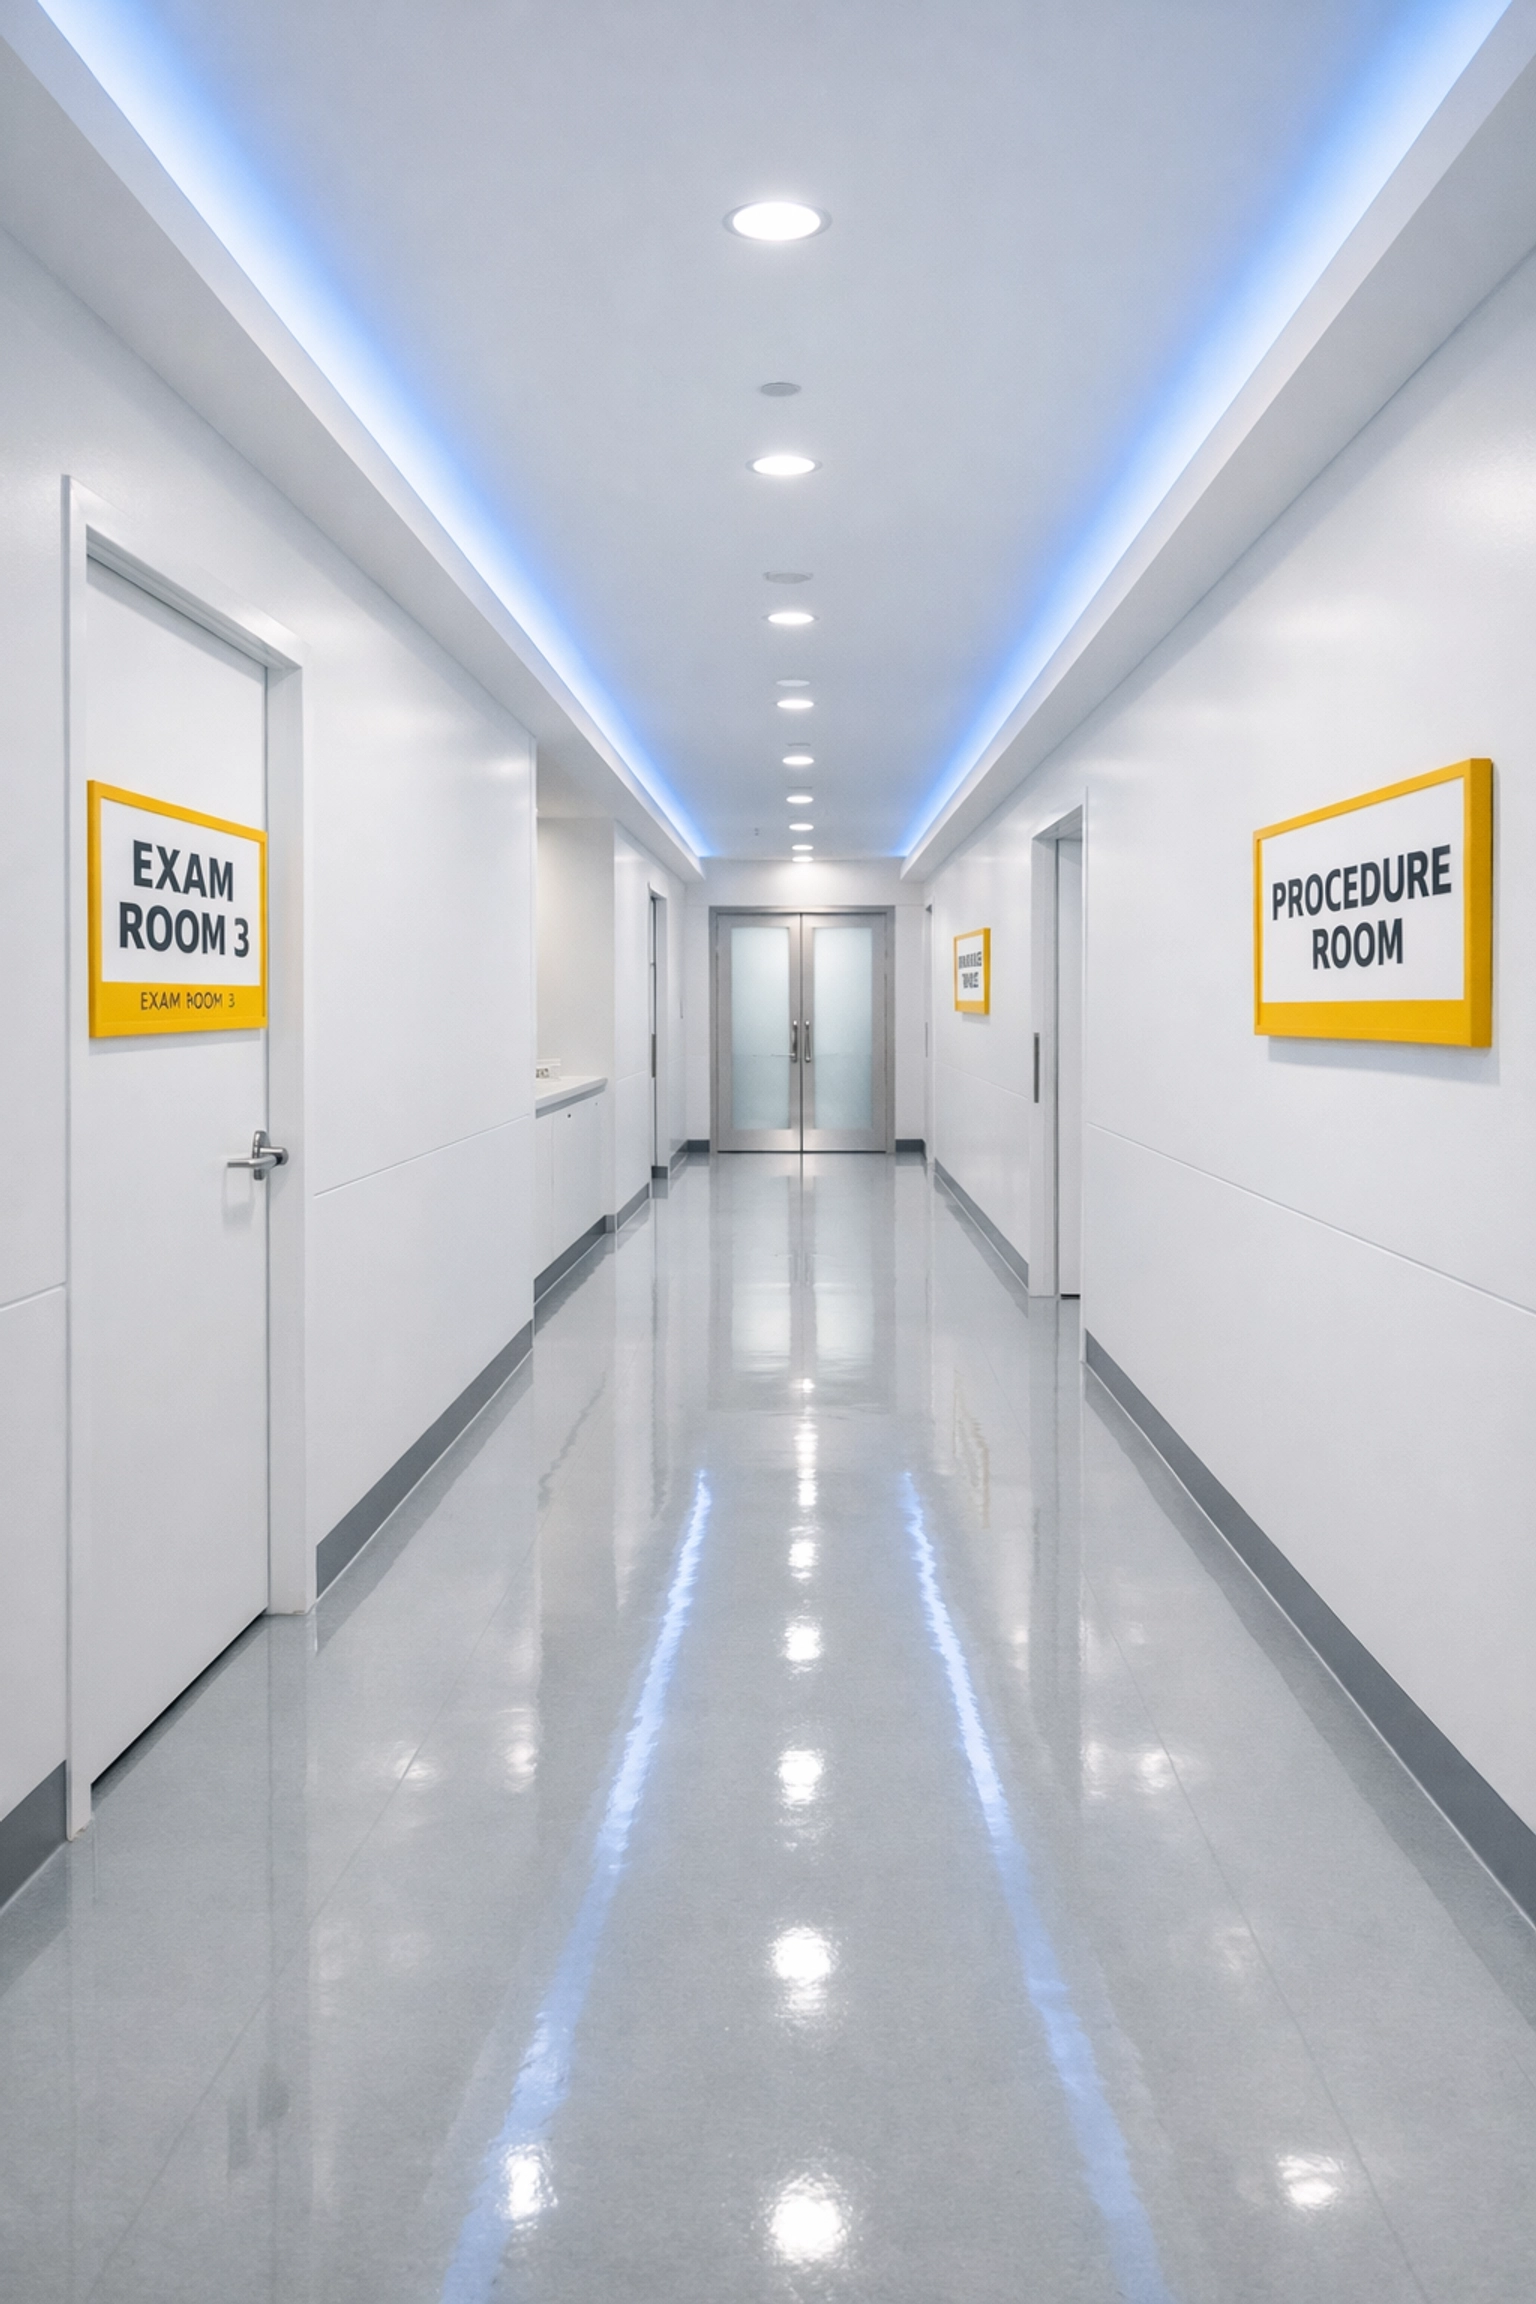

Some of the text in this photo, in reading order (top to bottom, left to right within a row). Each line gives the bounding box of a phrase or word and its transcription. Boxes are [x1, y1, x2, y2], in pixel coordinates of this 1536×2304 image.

[133, 839, 234, 902] EXAM
[1271, 844, 1452, 921] PROCEDURE
[119, 901, 249, 958] ROOM 3
[1312, 917, 1404, 970] ROOM
[140, 991, 235, 1011] EXAM ROOM 3
